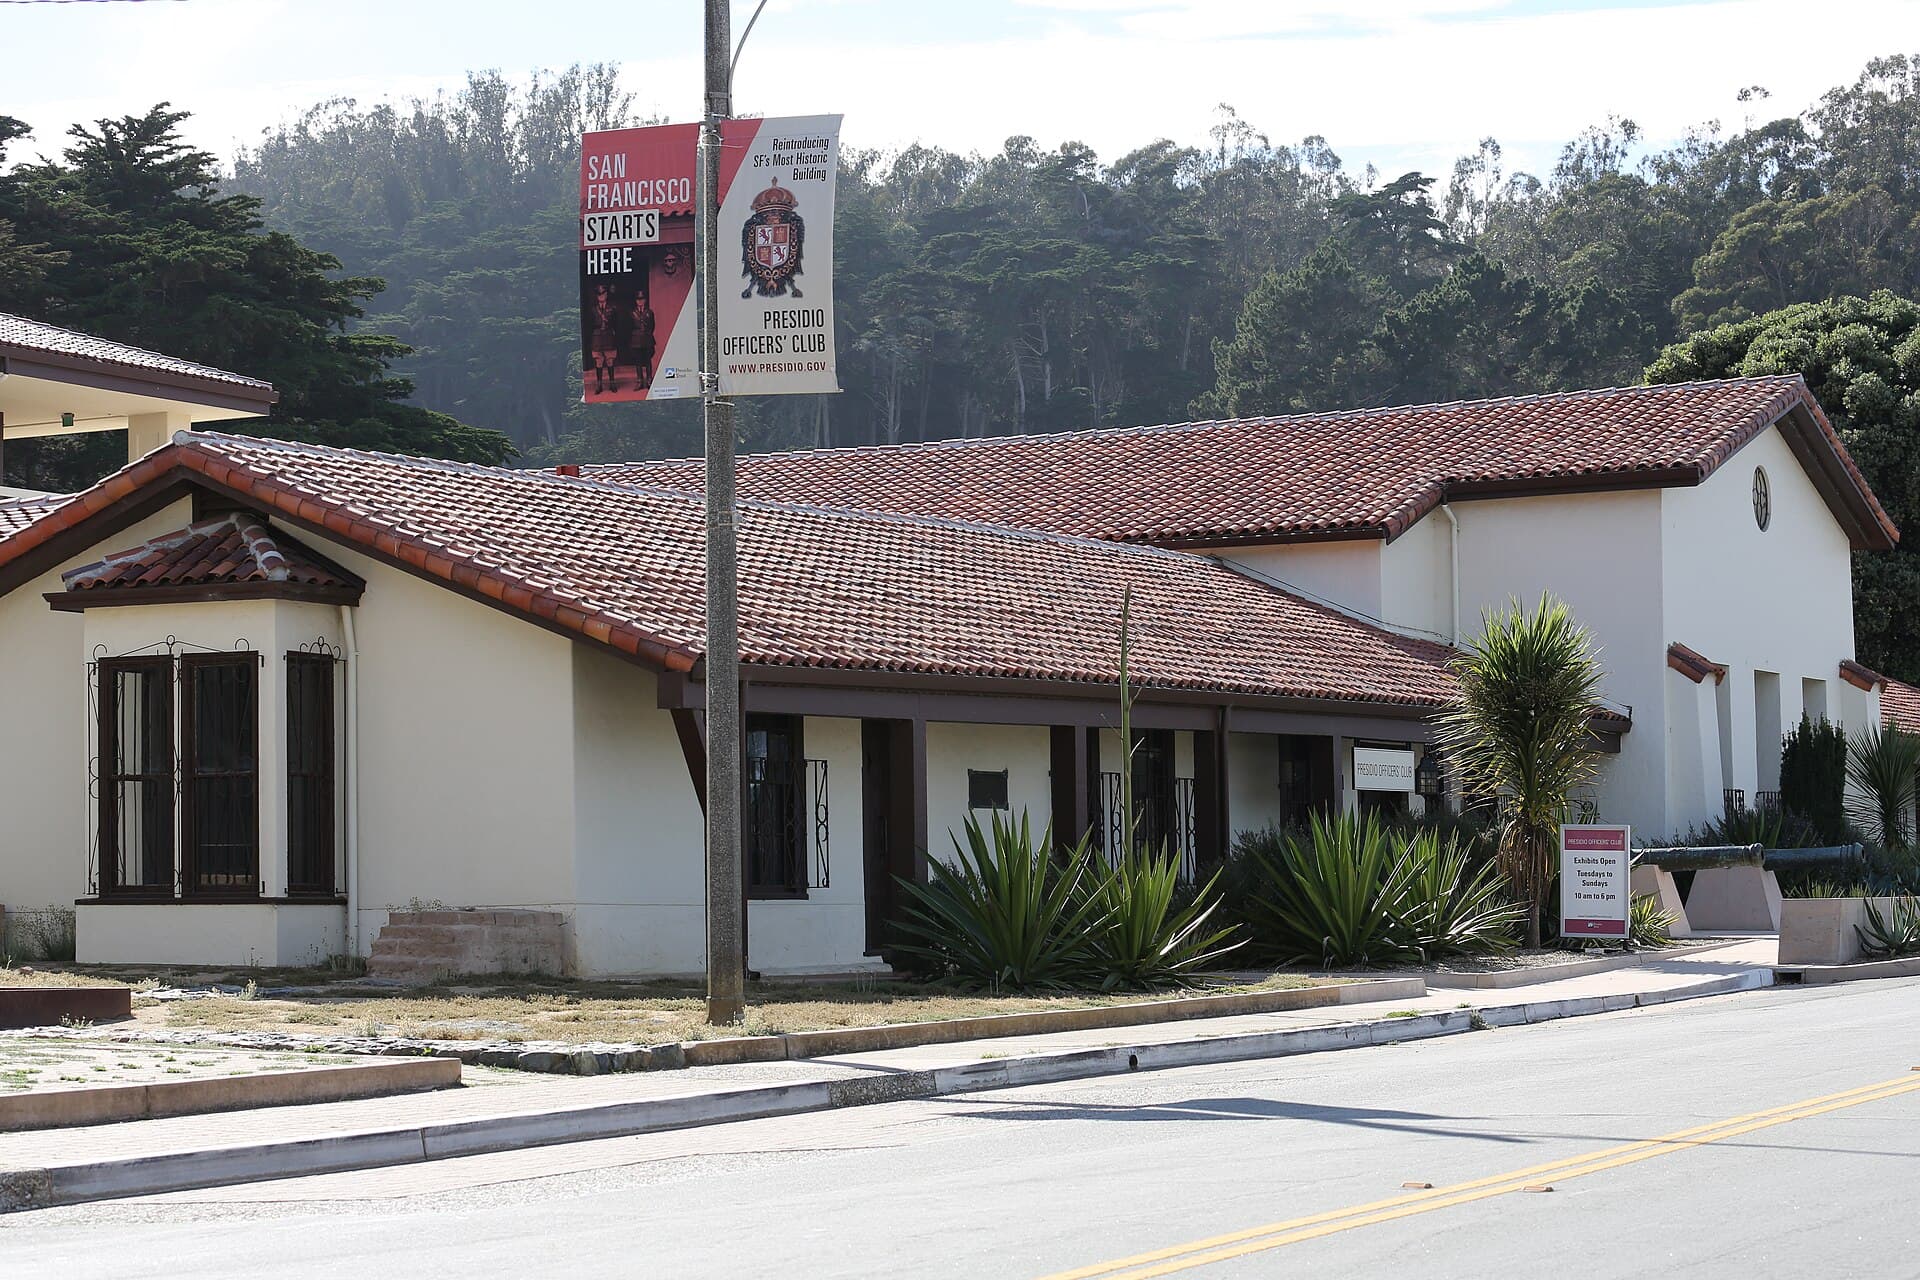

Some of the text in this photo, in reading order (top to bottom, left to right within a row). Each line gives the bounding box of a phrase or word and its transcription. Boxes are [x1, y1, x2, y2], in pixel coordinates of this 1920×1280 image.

[772, 136, 829, 151] Reintroducing
[588, 153, 626, 180] SAN
[753, 151, 828, 168] SF's Most Historic
[792, 167, 826, 181] Building
[587, 178, 690, 209] FRANCISCO
[587, 213, 656, 242] STARTS
[587, 247, 632, 275] HERE
[764, 309, 824, 329] PRESIDIO
[723, 333, 826, 356] OFFICERS' CLUB
[728, 361, 826, 374] WWW.PRESIDIO.GOV
[1357, 763, 1378, 776] PRESIDIO
[1401, 765, 1413, 778] CLUB
[1573, 857, 1616, 866] Exhibits Open
[1576, 870, 1605, 879] Tuesdays
[1581, 880, 1608, 888] Sundays
[1600, 892, 1605, 900] 6
